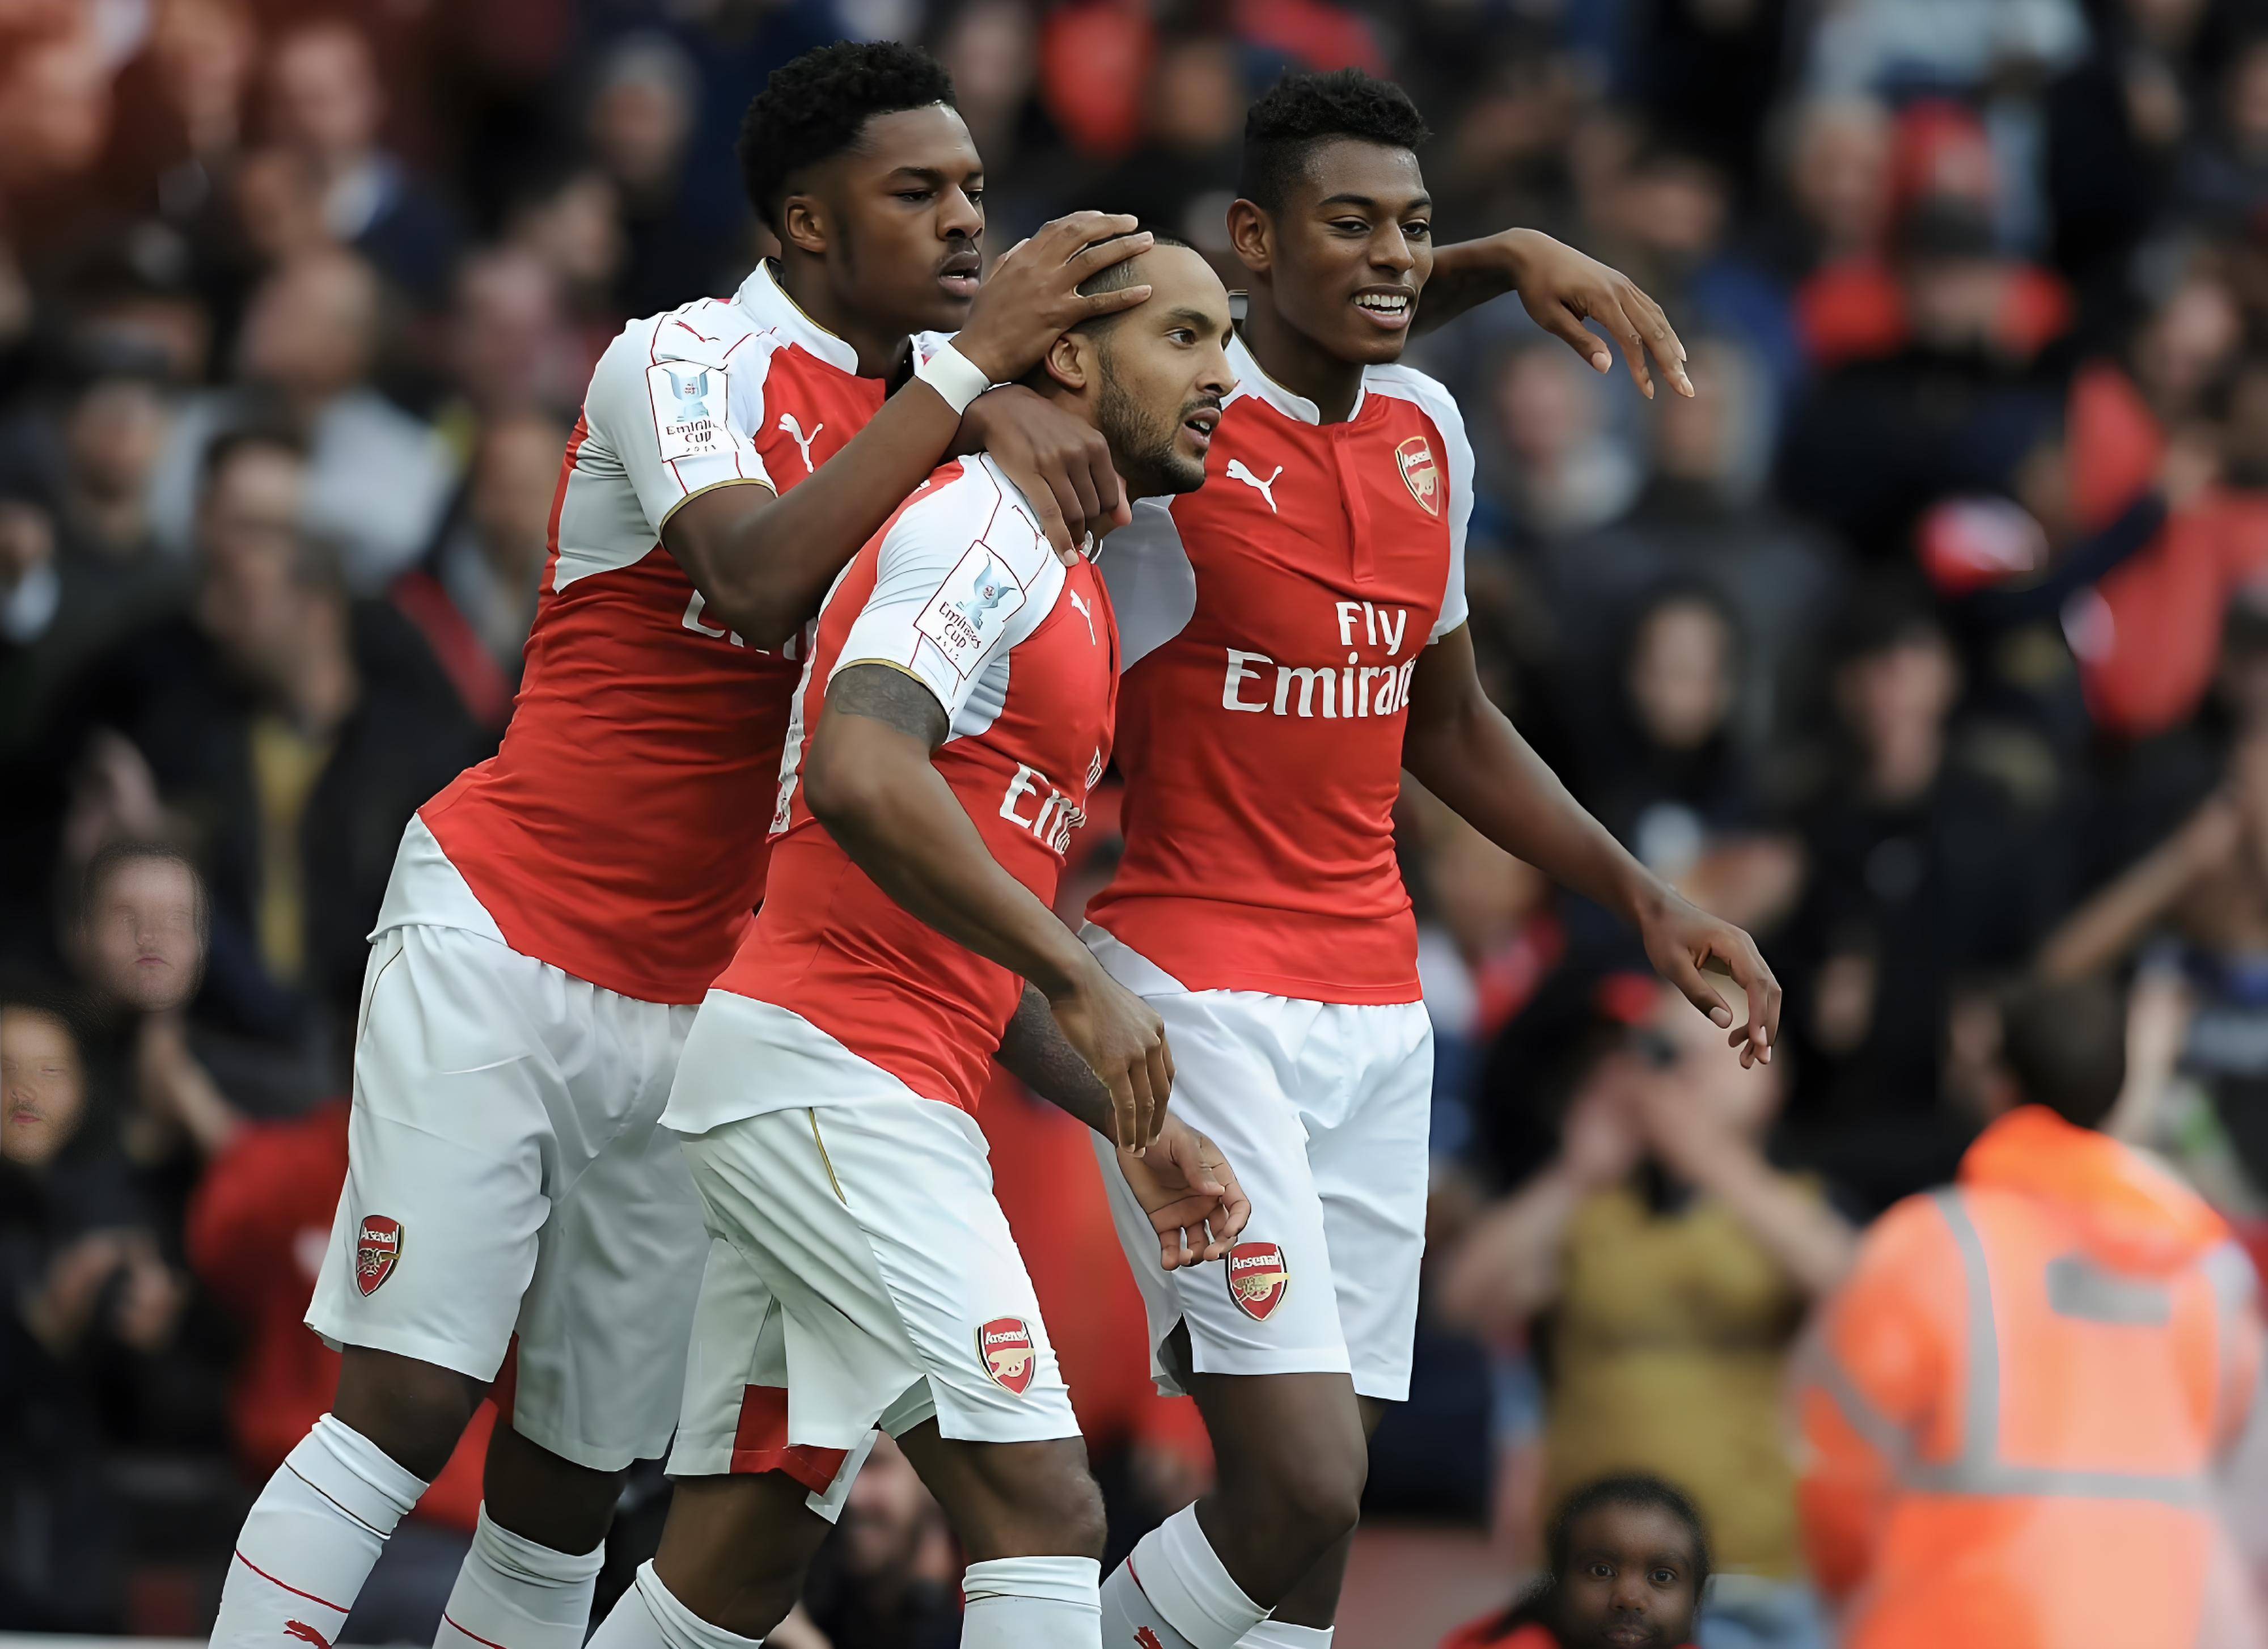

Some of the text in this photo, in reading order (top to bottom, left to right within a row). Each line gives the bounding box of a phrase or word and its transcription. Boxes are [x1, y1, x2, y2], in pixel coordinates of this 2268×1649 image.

[945, 623, 966, 648] Cup
[1335, 601, 1407, 656] Fly
[1232, 1251, 1280, 1271] Arsenal
